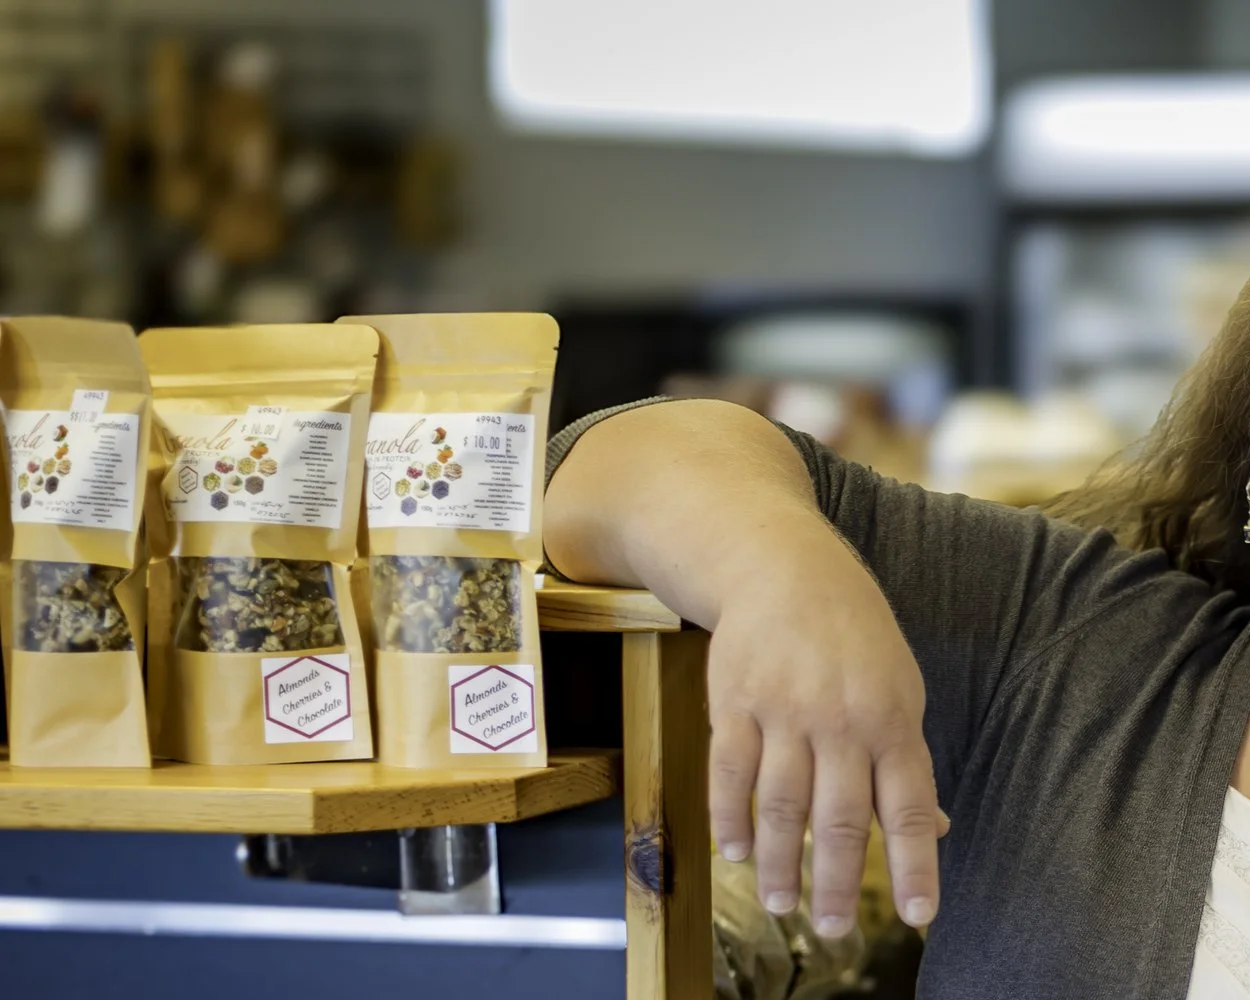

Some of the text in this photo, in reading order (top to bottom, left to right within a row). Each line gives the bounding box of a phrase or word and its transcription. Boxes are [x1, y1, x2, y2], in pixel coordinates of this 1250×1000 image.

[475, 416, 501, 425] 49943
[475, 436, 500, 449] 10.00
[278, 669, 320, 698] Almonds
[465, 679, 508, 707] Almonds
[282, 681, 332, 715] Cherries &
[468, 692, 519, 726] Cherries &
[297, 698, 343, 727] Chocolate
[482, 711, 529, 739] Chocolate
